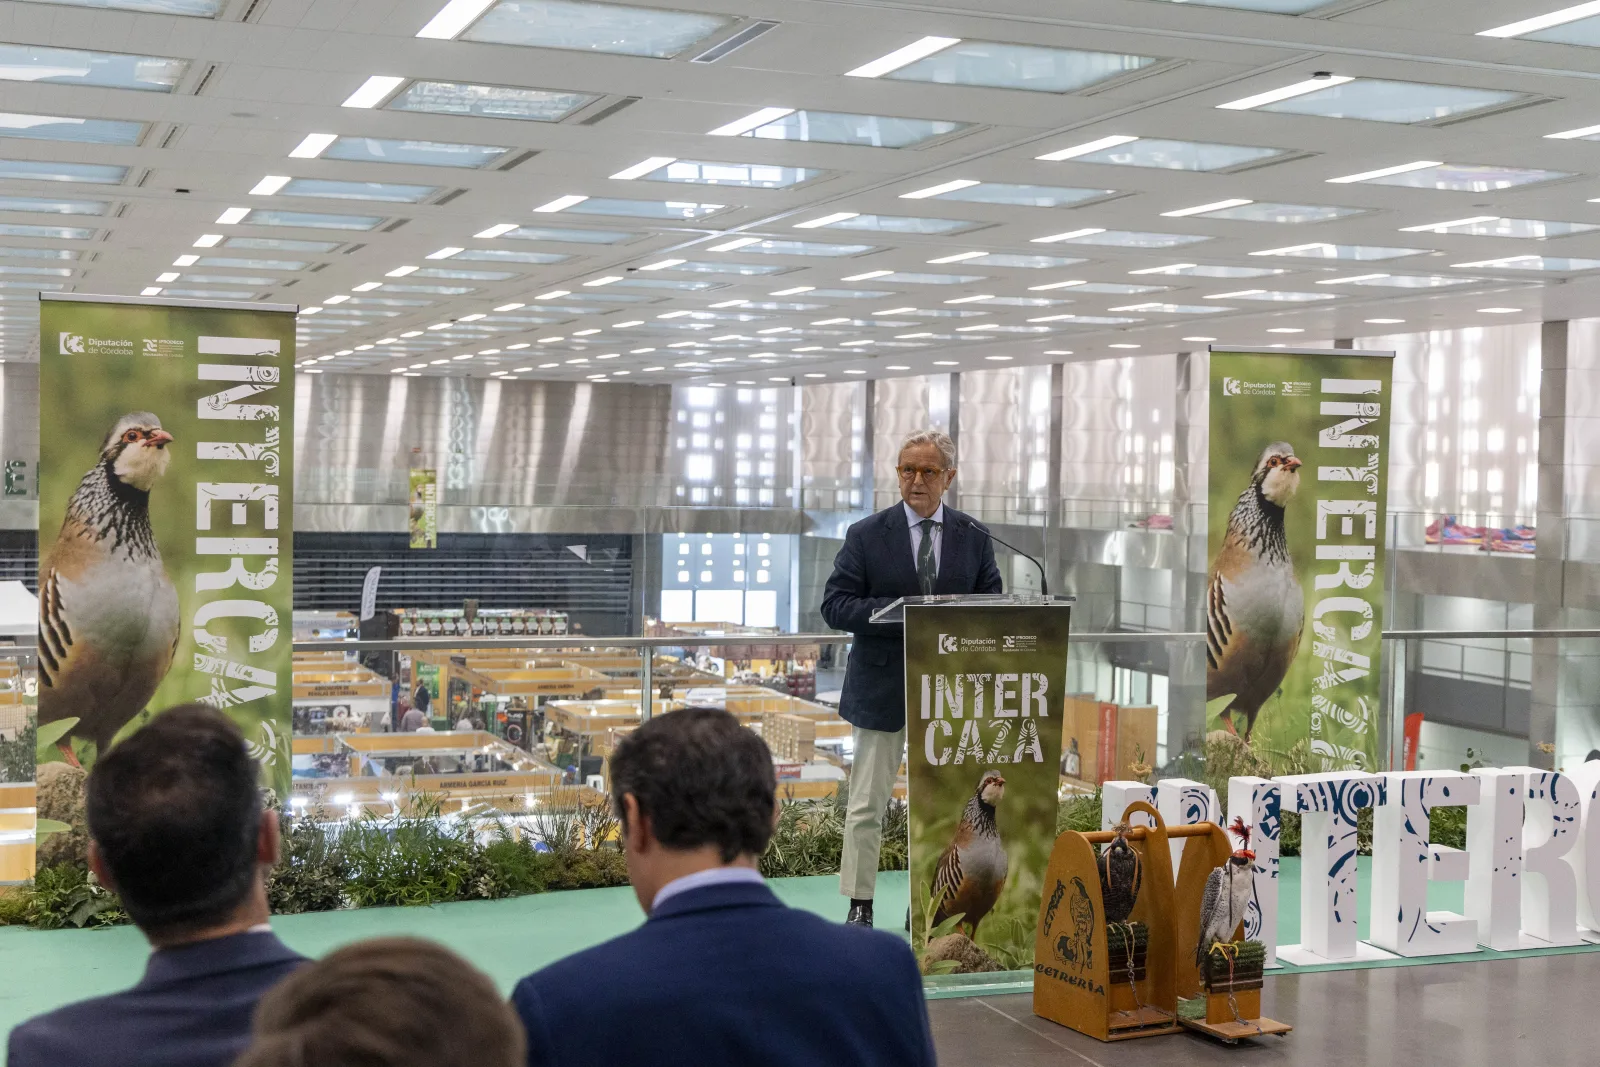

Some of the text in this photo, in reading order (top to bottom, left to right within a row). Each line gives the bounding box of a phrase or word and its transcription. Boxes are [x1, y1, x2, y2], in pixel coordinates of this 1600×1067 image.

[88, 337, 133, 349] Diputación
[100, 347, 134, 356] Córdoba
[1243, 381, 1276, 389] Diputación
[960, 637, 996, 645] Diputación
[969, 645, 996, 653] Córdoba
[920, 672, 1050, 719] INTER
[924, 718, 1045, 766] CAZA
[439, 778, 508, 789] ARMERIA GARCIA RUIZ
